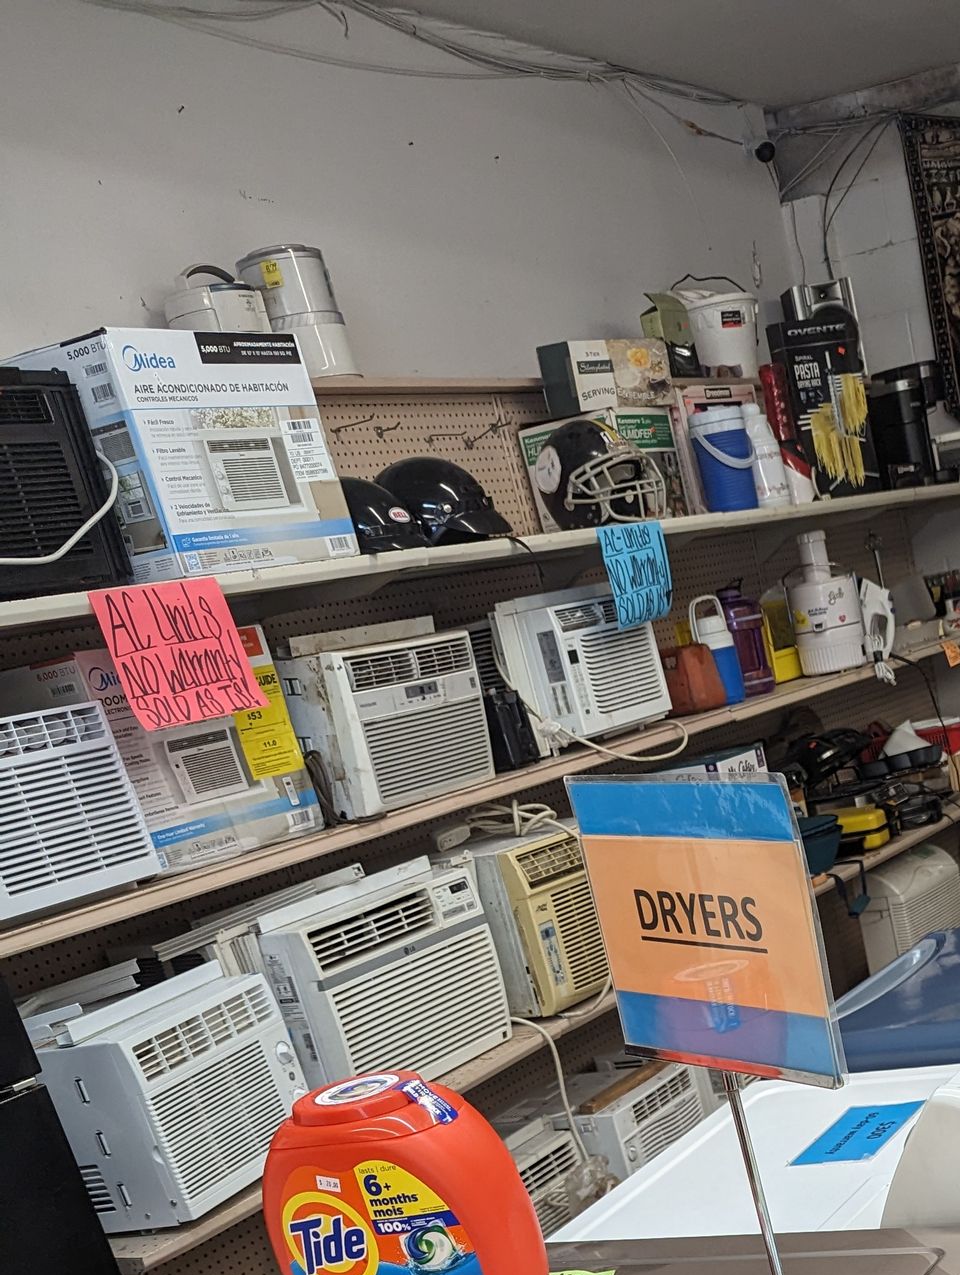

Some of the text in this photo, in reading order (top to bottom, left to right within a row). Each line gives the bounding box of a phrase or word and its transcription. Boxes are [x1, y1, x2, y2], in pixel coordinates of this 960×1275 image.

[787, 323, 846, 337] OVENTE
[67, 346, 90, 360] 5,000
[200, 345, 218, 354] 5,000
[218, 345, 231, 353] BTU
[124, 347, 175, 372] Midea
[793, 362, 820, 380] PASTA
[134, 381, 289, 394] AIRE ACONDICIONADO DE HABITACIÓN
[581, 388, 616, 401] SERVING
[105, 590, 153, 656] AC
[122, 656, 159, 698] NO
[135, 695, 192, 727] SOLD
[633, 888, 763, 941] DRYERS
[358, 1164, 396, 1175] lasts dure
[363, 1175, 391, 1197] 6+
[369, 1193, 418, 1207] months
[373, 1206, 404, 1218] mois
[378, 1221, 411, 1234] 100%
[290, 1217, 366, 1275] Tide
